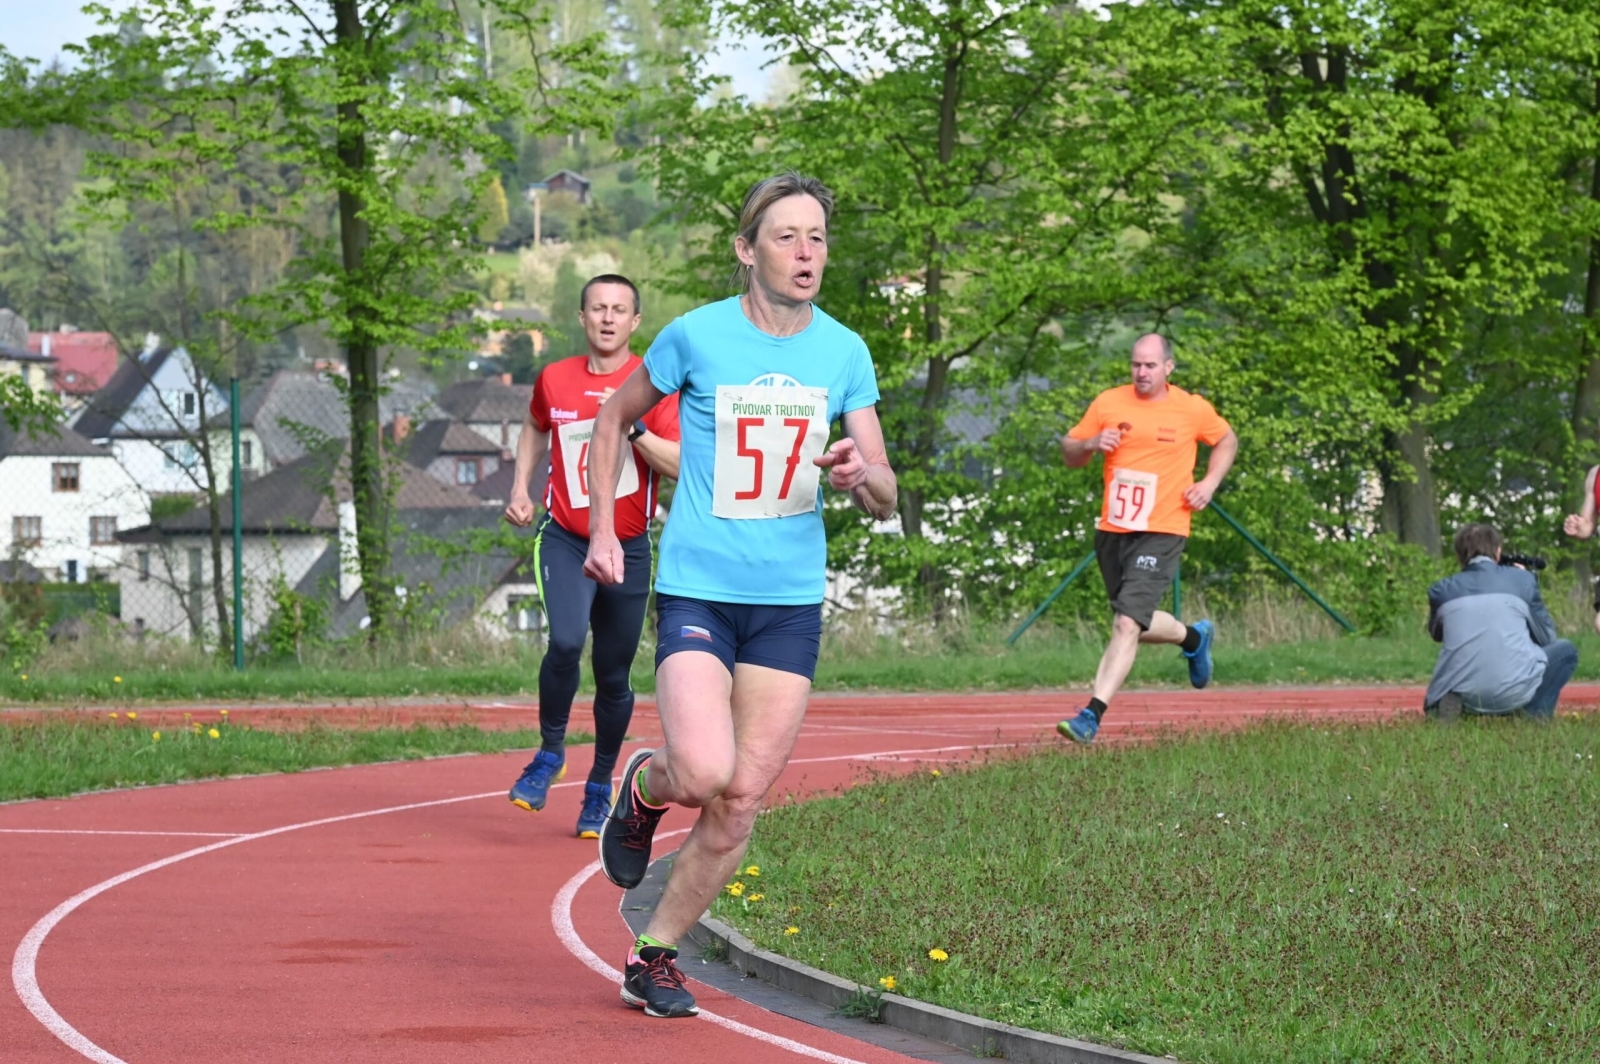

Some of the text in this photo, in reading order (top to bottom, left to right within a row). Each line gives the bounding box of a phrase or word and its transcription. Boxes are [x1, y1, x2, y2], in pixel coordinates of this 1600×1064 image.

[732, 403, 816, 417] PIVOVAR TRUTNOV
[735, 417, 810, 500] 57
[1114, 483, 1145, 522] 59
